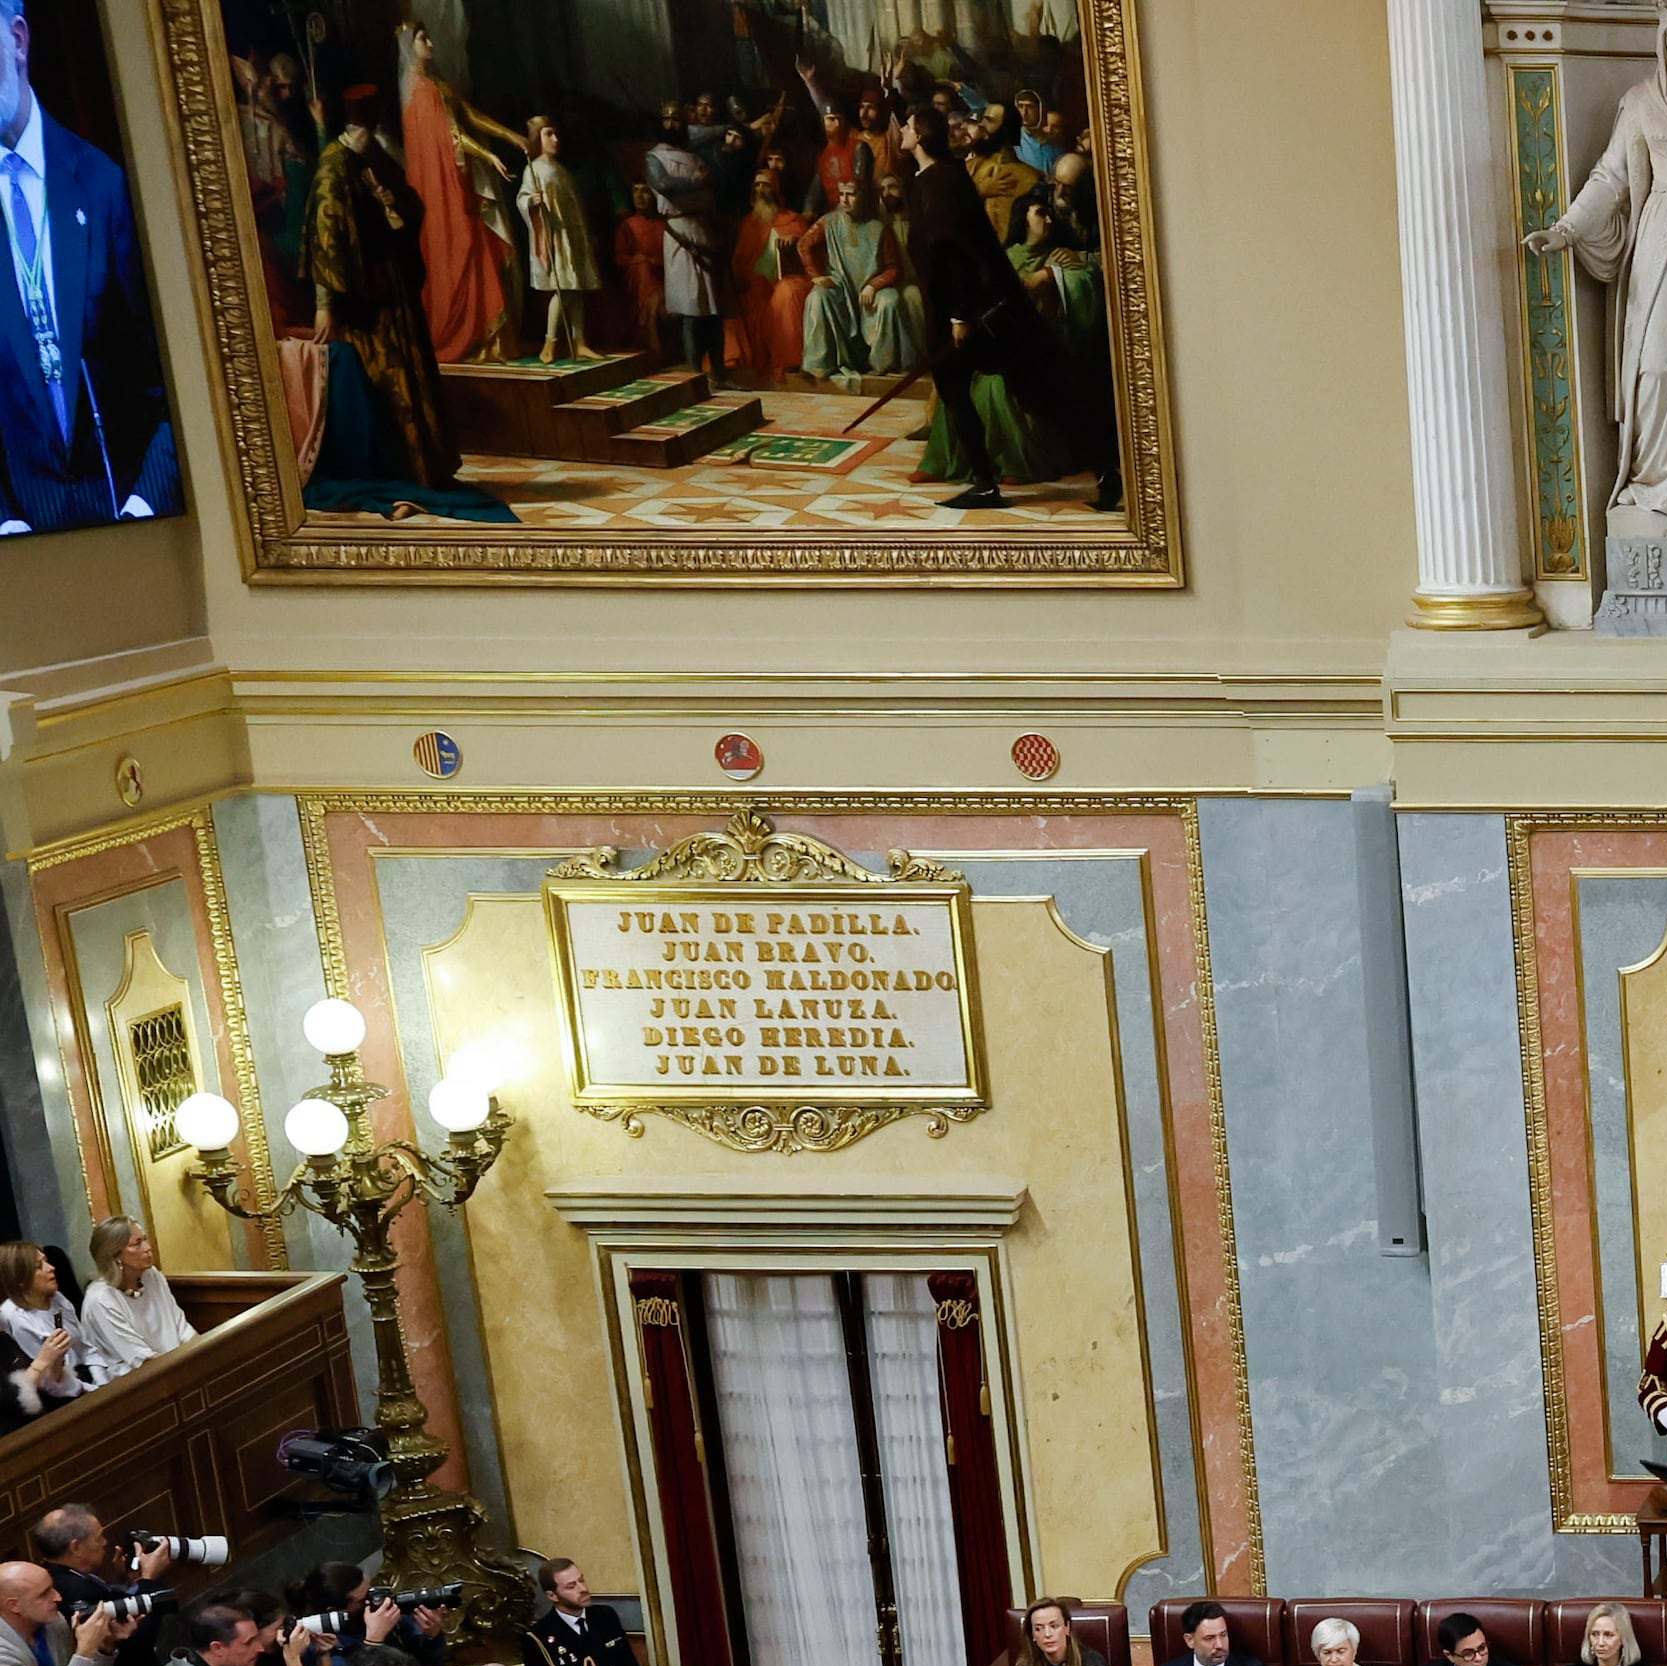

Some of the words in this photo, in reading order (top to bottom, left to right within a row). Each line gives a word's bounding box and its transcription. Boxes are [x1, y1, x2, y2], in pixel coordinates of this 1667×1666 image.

[617, 911, 700, 933] JUAN
[711, 912, 756, 934] DE
[766, 912, 921, 936] PADILLA.
[662, 940, 744, 962] JUAN
[754, 941, 876, 963] BRAVO.
[581, 968, 751, 990] FRANCISCO
[650, 997, 737, 1019] JUAN
[753, 998, 898, 1020] LANUZA.
[642, 1026, 746, 1047] DIEGO
[759, 1026, 916, 1048] HEREDIA.
[655, 1055, 744, 1075] JUAN
[757, 1055, 802, 1076] DE
[814, 1055, 911, 1077] LUNA.
